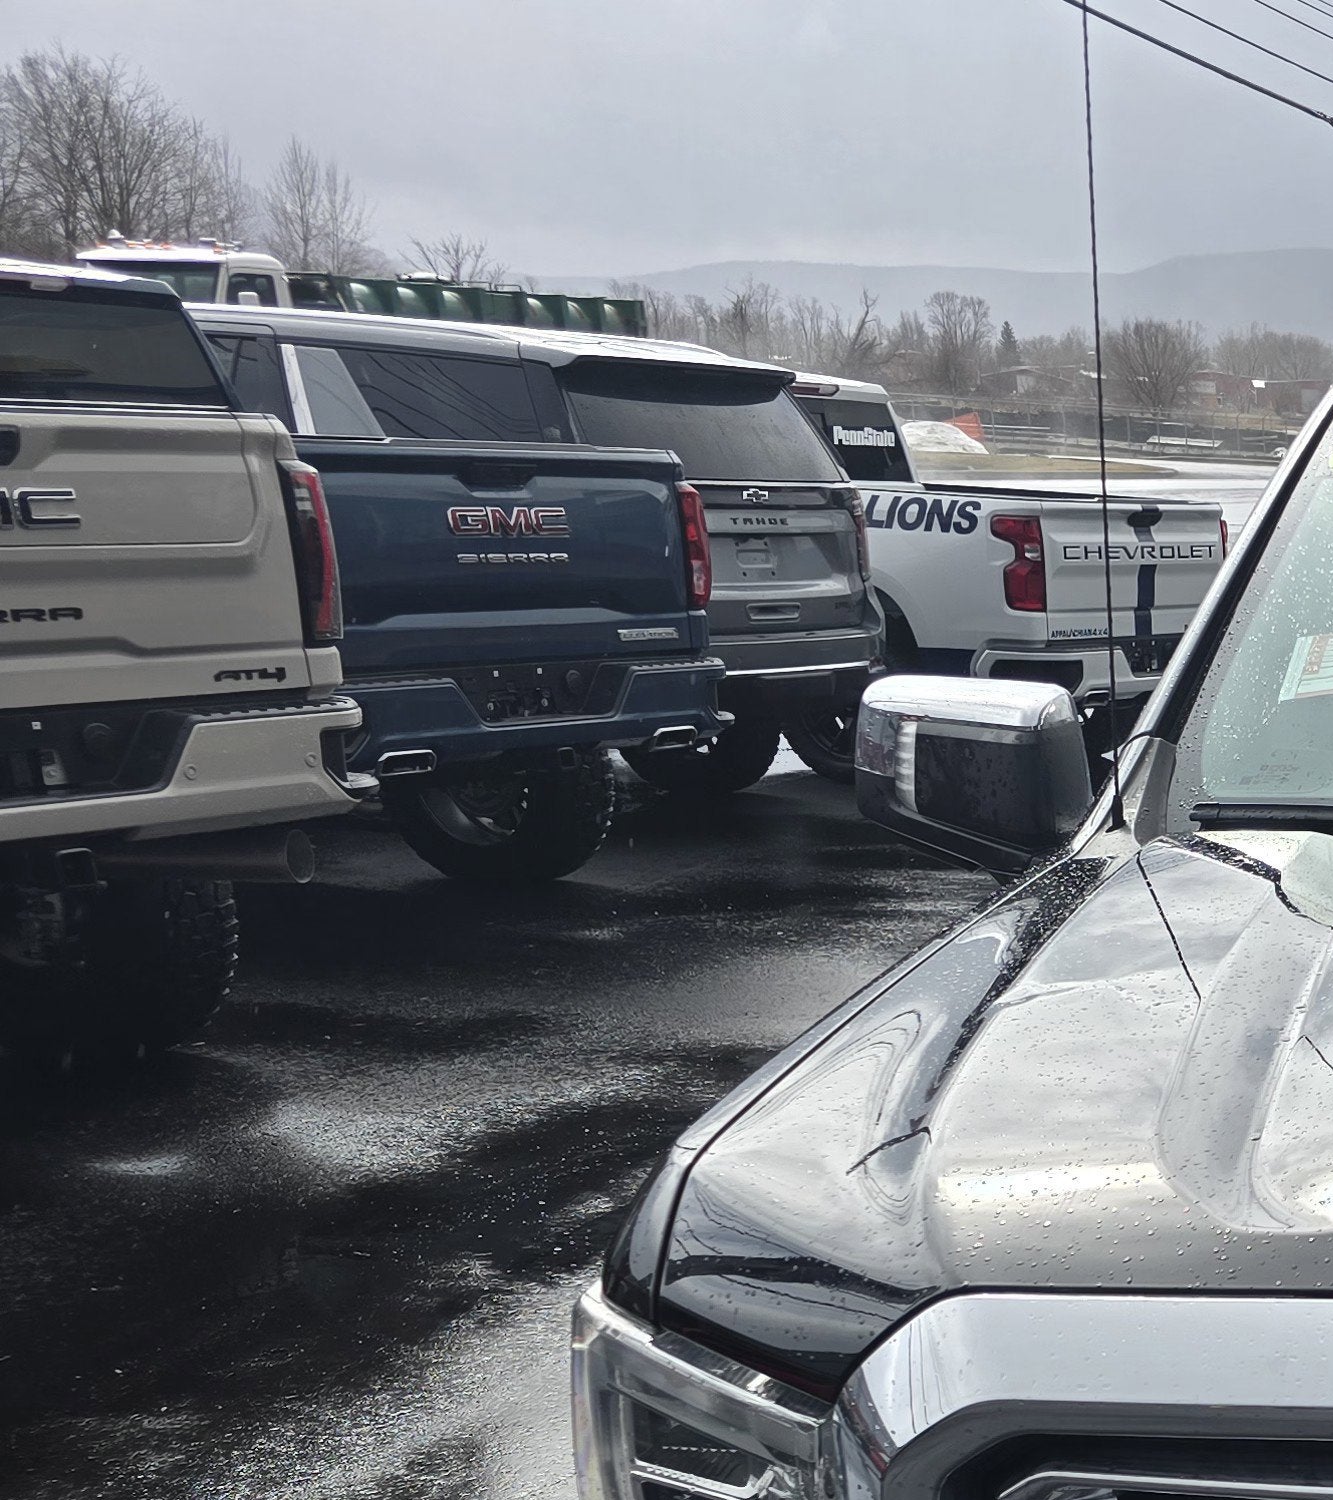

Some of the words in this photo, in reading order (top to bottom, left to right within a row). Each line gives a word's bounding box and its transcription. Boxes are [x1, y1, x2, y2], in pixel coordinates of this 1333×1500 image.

[446, 506, 570, 536] GMC
[729, 517, 789, 526] TAHOE
[865, 494, 982, 535] LIONS
[457, 553, 570, 563] SIERRA
[1063, 544, 1217, 560] CHEVROLET
[213, 667, 287, 683] AT4
